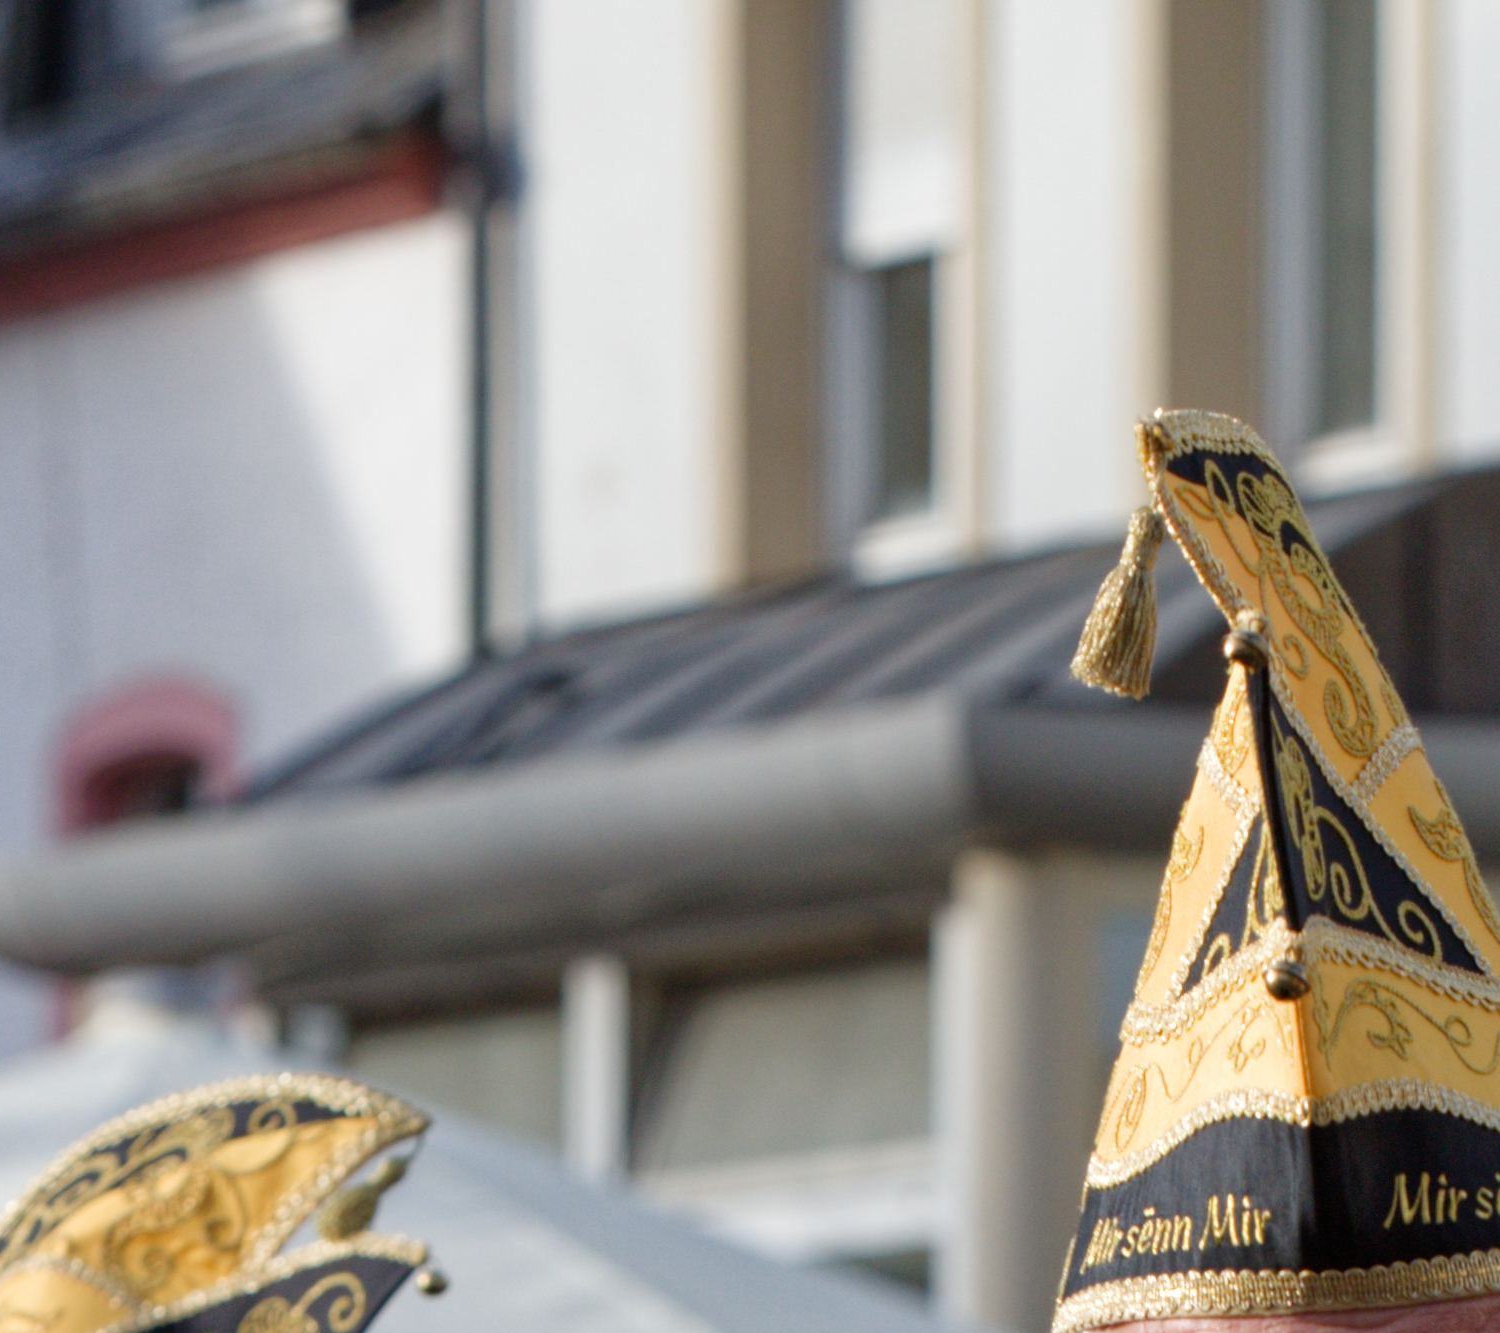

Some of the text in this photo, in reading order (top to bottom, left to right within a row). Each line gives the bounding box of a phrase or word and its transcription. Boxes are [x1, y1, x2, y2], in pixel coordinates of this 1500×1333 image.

[1121, 1205, 1193, 1259] sënn
[1198, 1193, 1272, 1251] Mir
[1383, 1171, 1468, 1231] Mir
